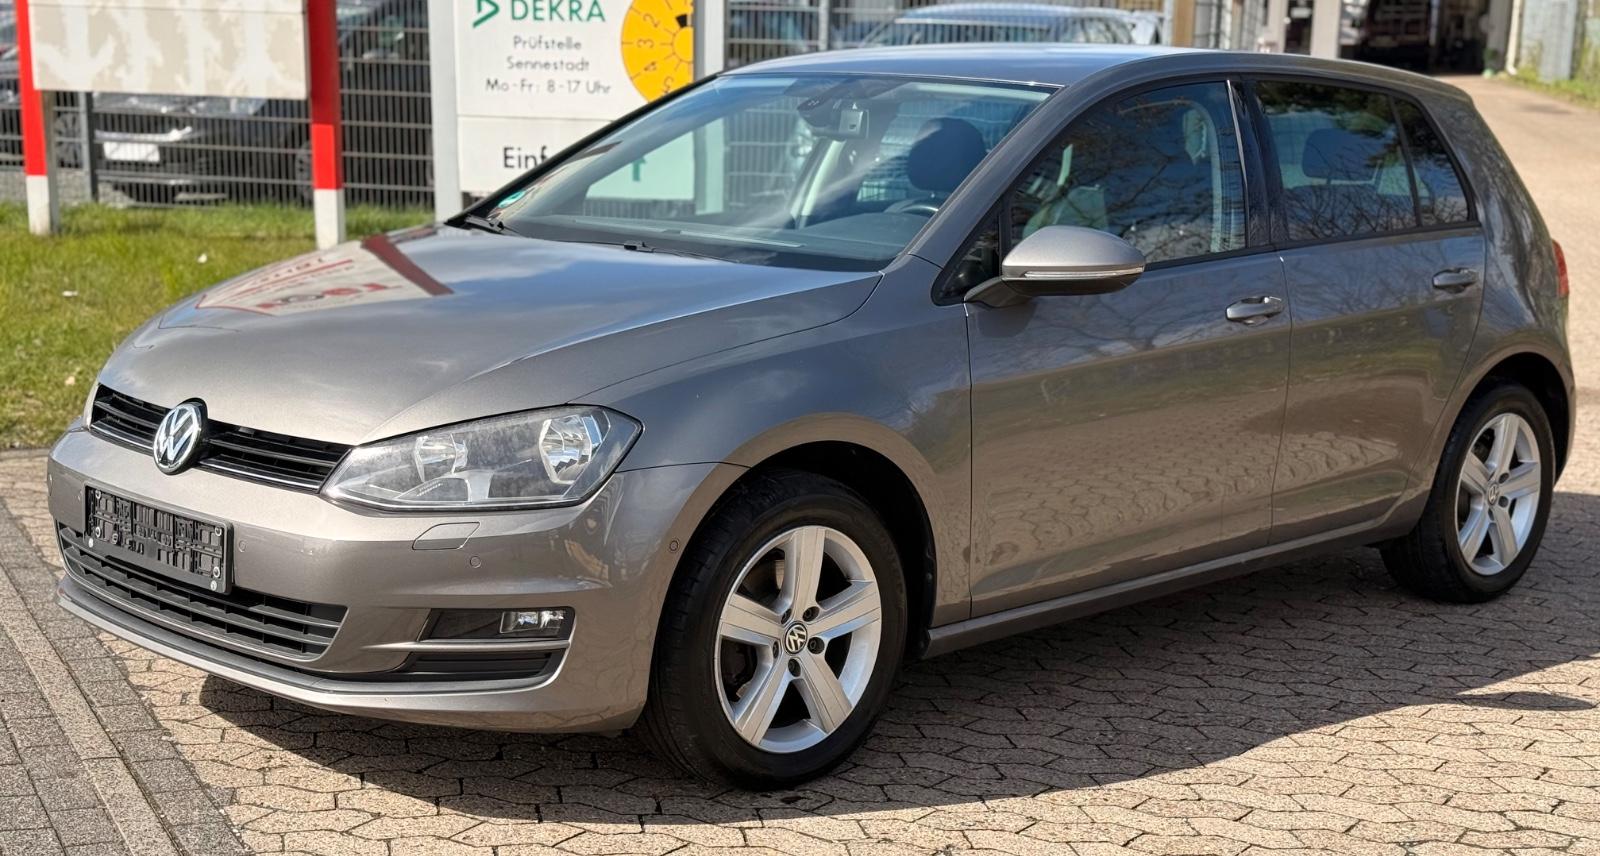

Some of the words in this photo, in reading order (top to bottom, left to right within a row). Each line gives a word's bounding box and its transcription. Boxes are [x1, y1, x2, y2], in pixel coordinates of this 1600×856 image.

[511, 0, 606, 22] DEKRA
[642, 12, 661, 28] 2
[513, 35, 582, 50] Prüfstelle
[636, 37, 655, 49] 3
[506, 56, 590, 71] Sennestadt
[585, 80, 612, 95] Uhr
[154, 403, 201, 468] VW
